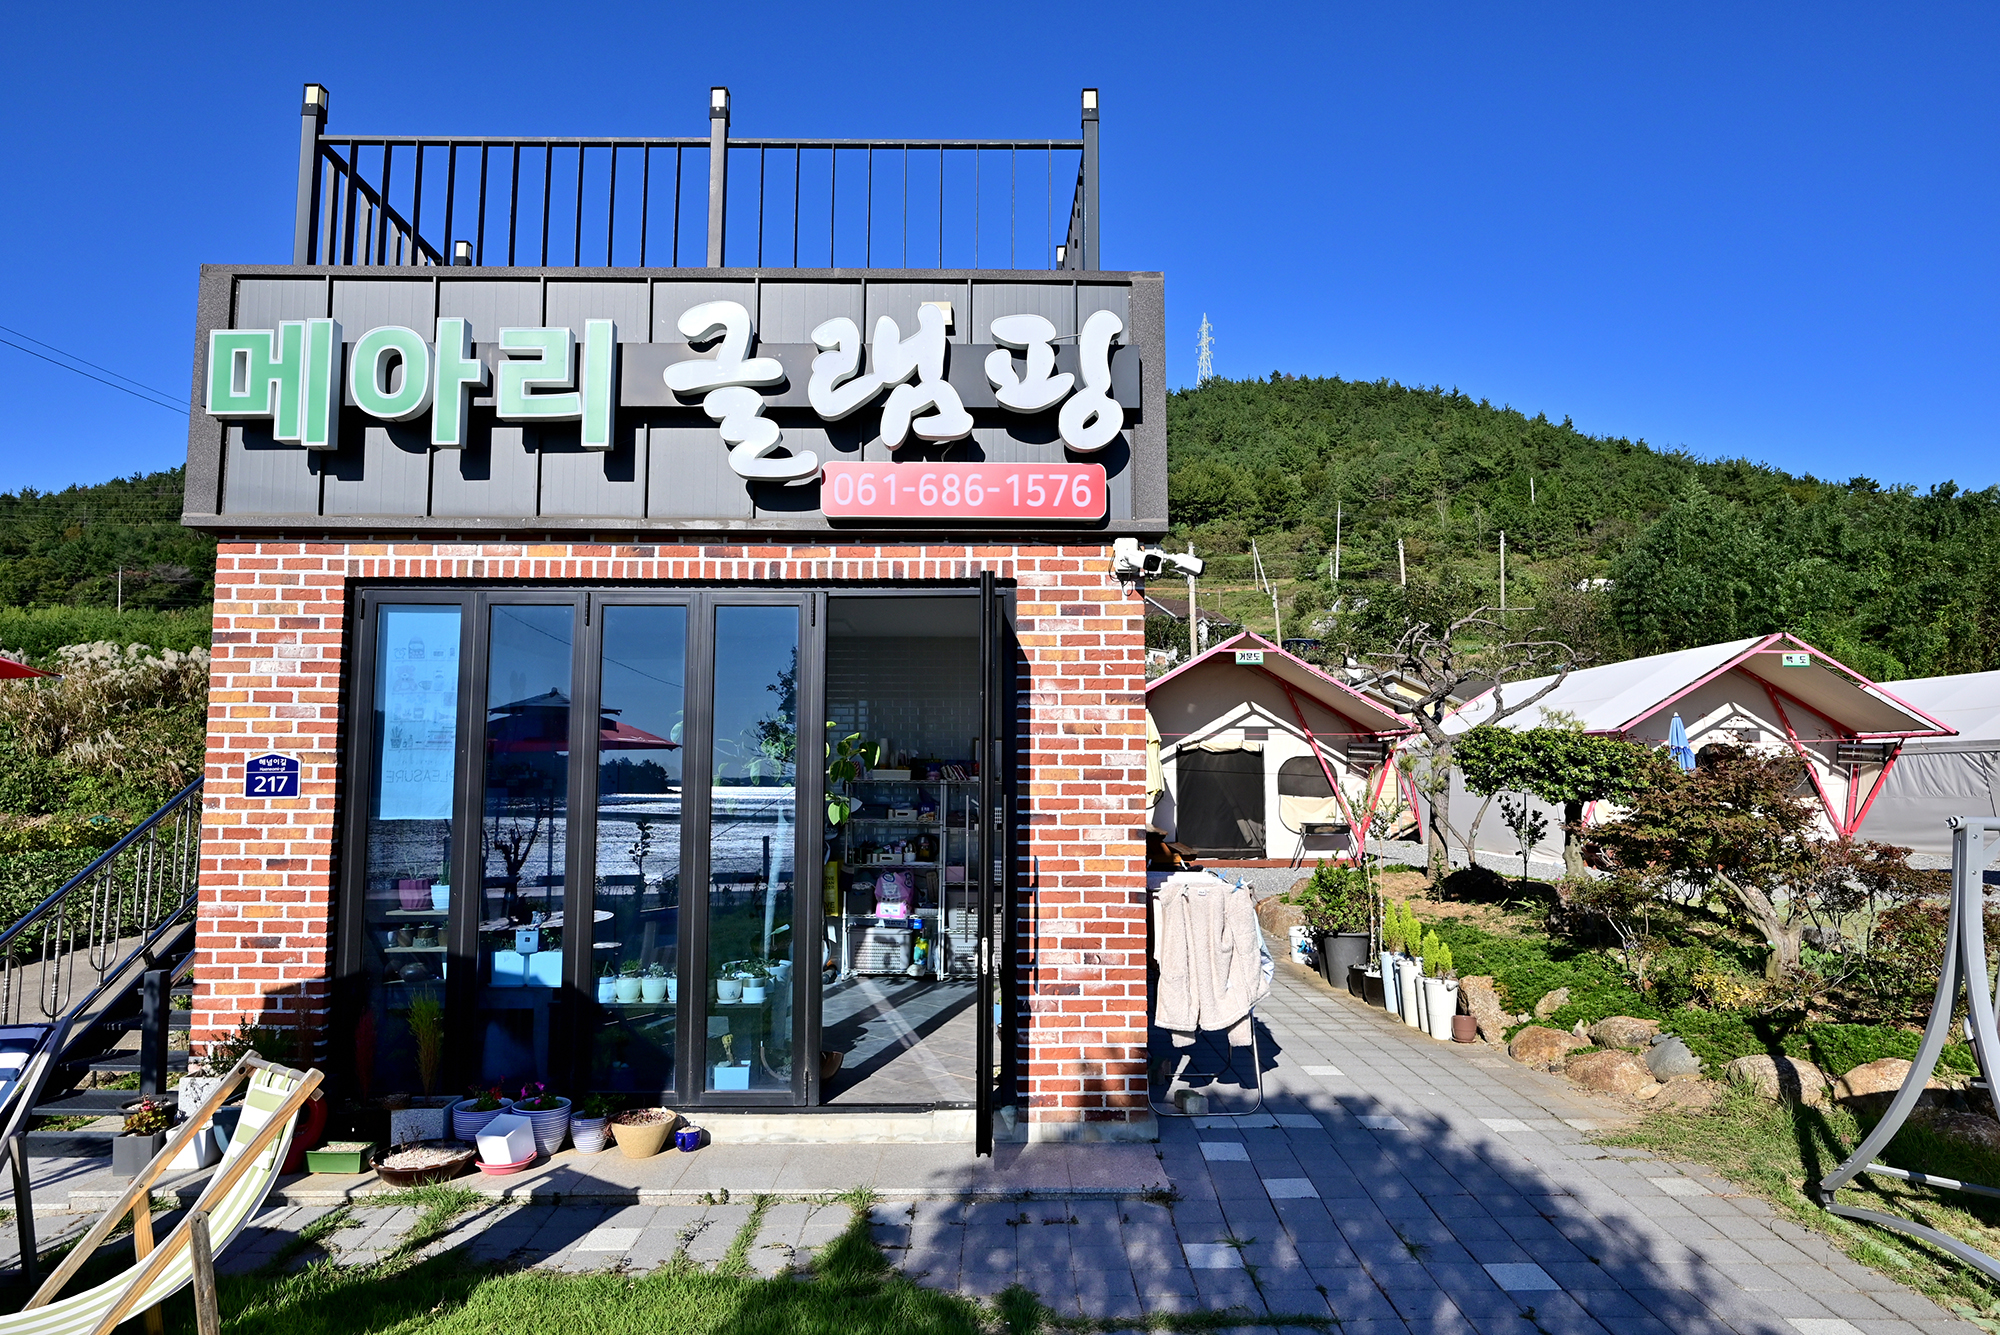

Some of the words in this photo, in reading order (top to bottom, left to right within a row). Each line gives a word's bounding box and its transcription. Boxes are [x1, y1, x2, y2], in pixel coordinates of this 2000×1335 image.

[206, 317, 617, 451] 메아리
[663, 300, 1124, 481] 글램핑
[834, 472, 1093, 507] 061-686-1576
[253, 775, 289, 793] 217
